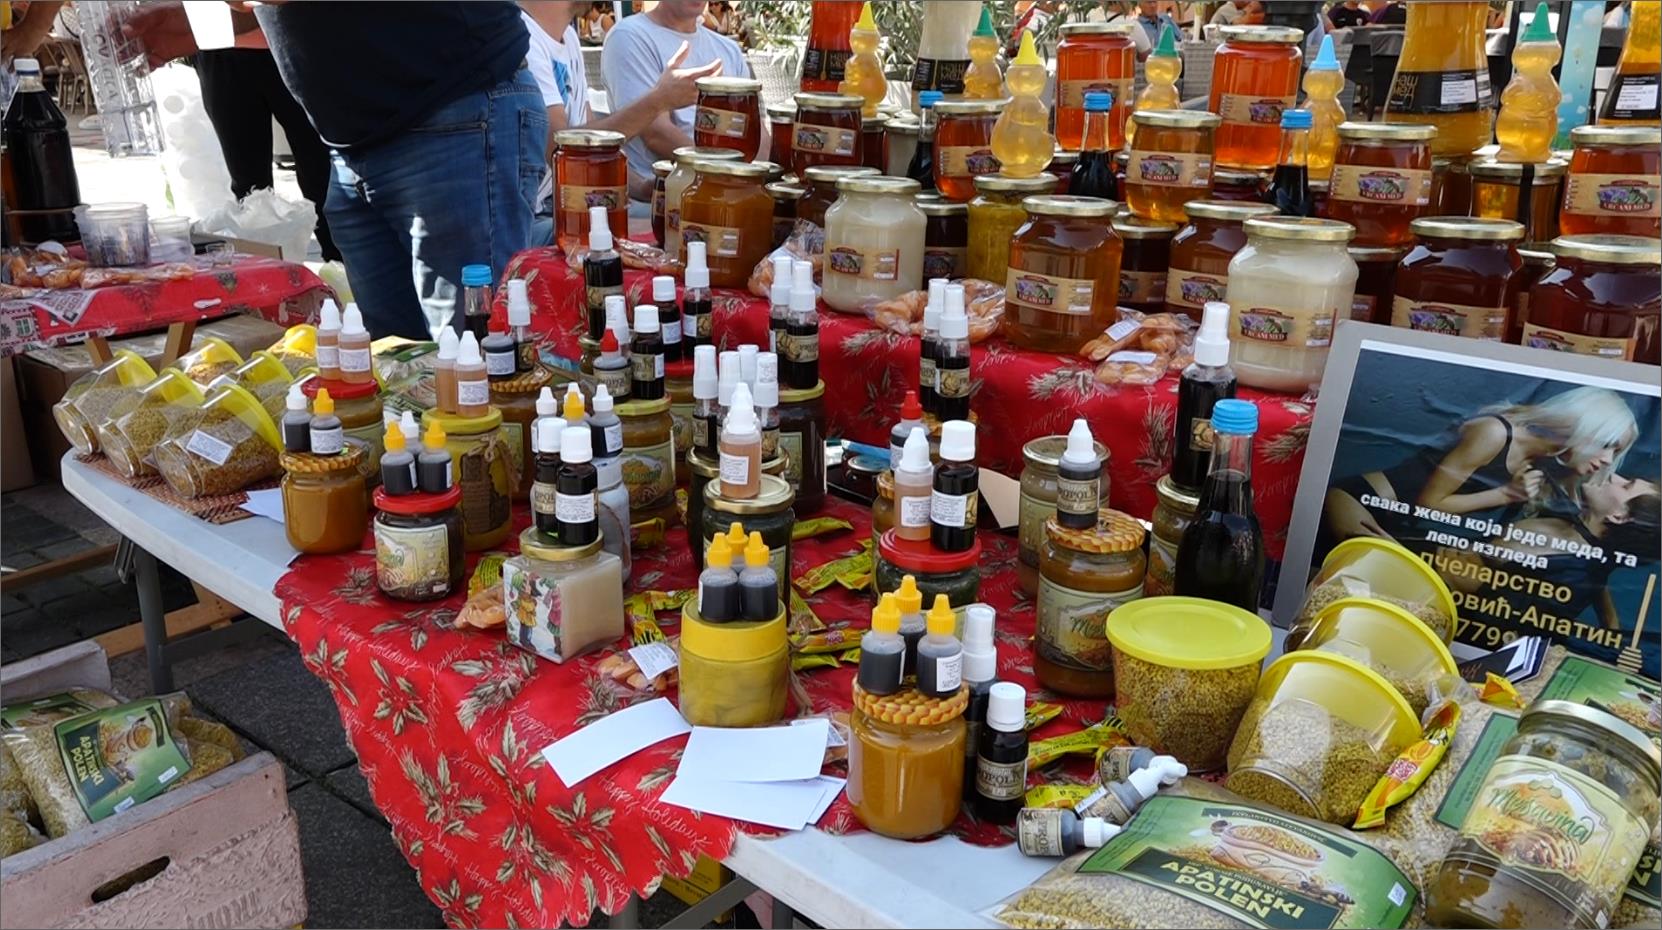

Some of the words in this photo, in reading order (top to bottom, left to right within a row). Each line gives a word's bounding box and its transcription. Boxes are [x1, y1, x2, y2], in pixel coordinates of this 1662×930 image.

[1360, 493, 1411, 515] свака
[1413, 504, 1462, 526] жена
[1464, 517, 1503, 538] која
[1503, 523, 1548, 547] једе
[1551, 537, 1608, 564] меда,
[1613, 551, 1639, 568] та
[1425, 530, 1470, 551] лепо
[1472, 541, 1549, 571] изгледа
[1420, 551, 1573, 604] пчеларство
[1451, 590, 1624, 649] овић-Апатин
[71, 746, 89, 783] POLEN
[80, 735, 105, 786] APATINSKI
[1160, 861, 1306, 920] APATINSKI
[1174, 873, 1271, 919] POLEN
